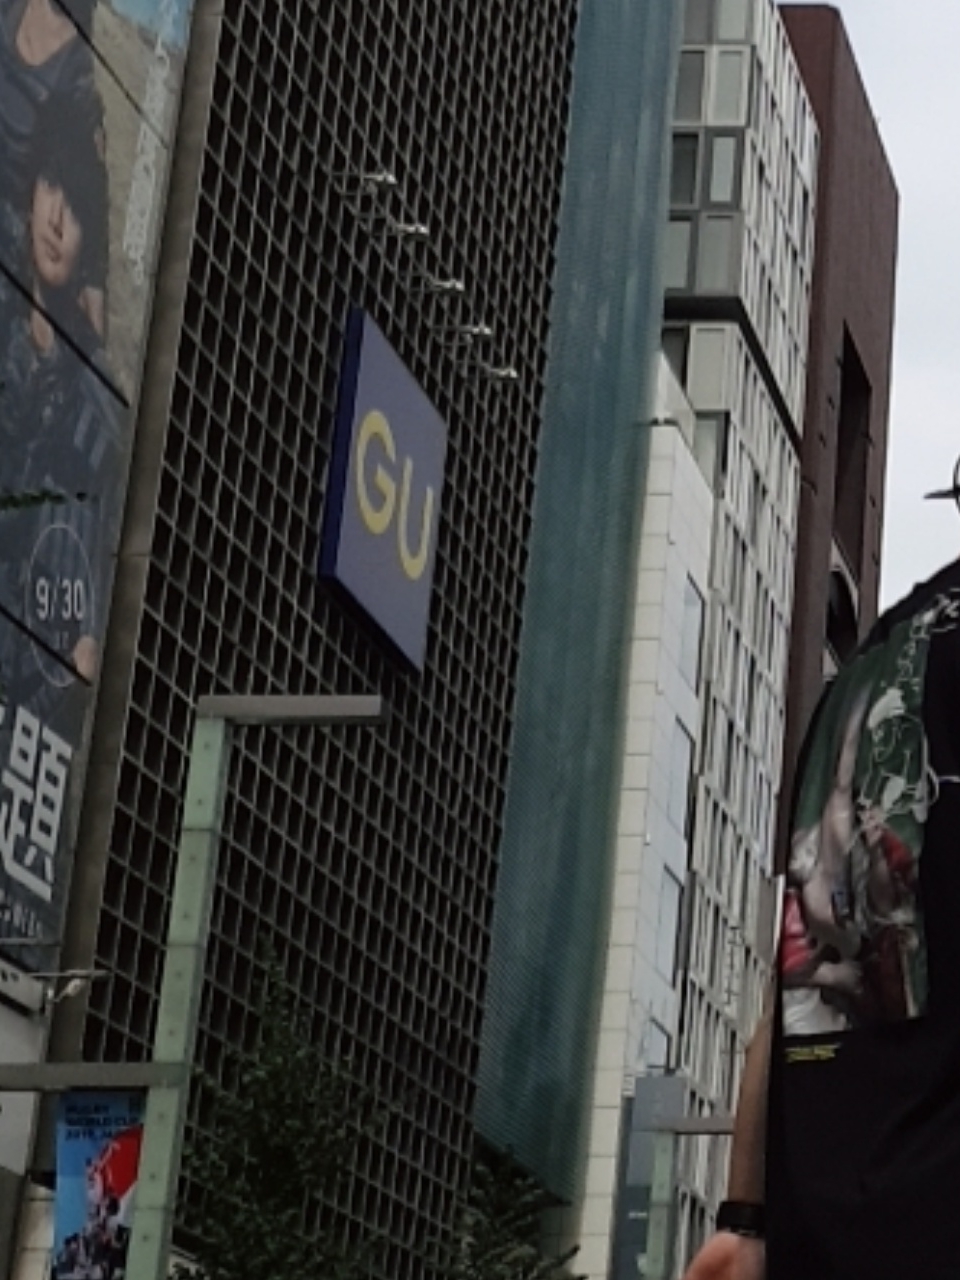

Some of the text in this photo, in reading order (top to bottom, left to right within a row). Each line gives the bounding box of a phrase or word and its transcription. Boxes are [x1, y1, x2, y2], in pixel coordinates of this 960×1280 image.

[355, 409, 434, 580] GU
[36, 577, 85, 619] 9/30
[0, 705, 73, 902] 題
